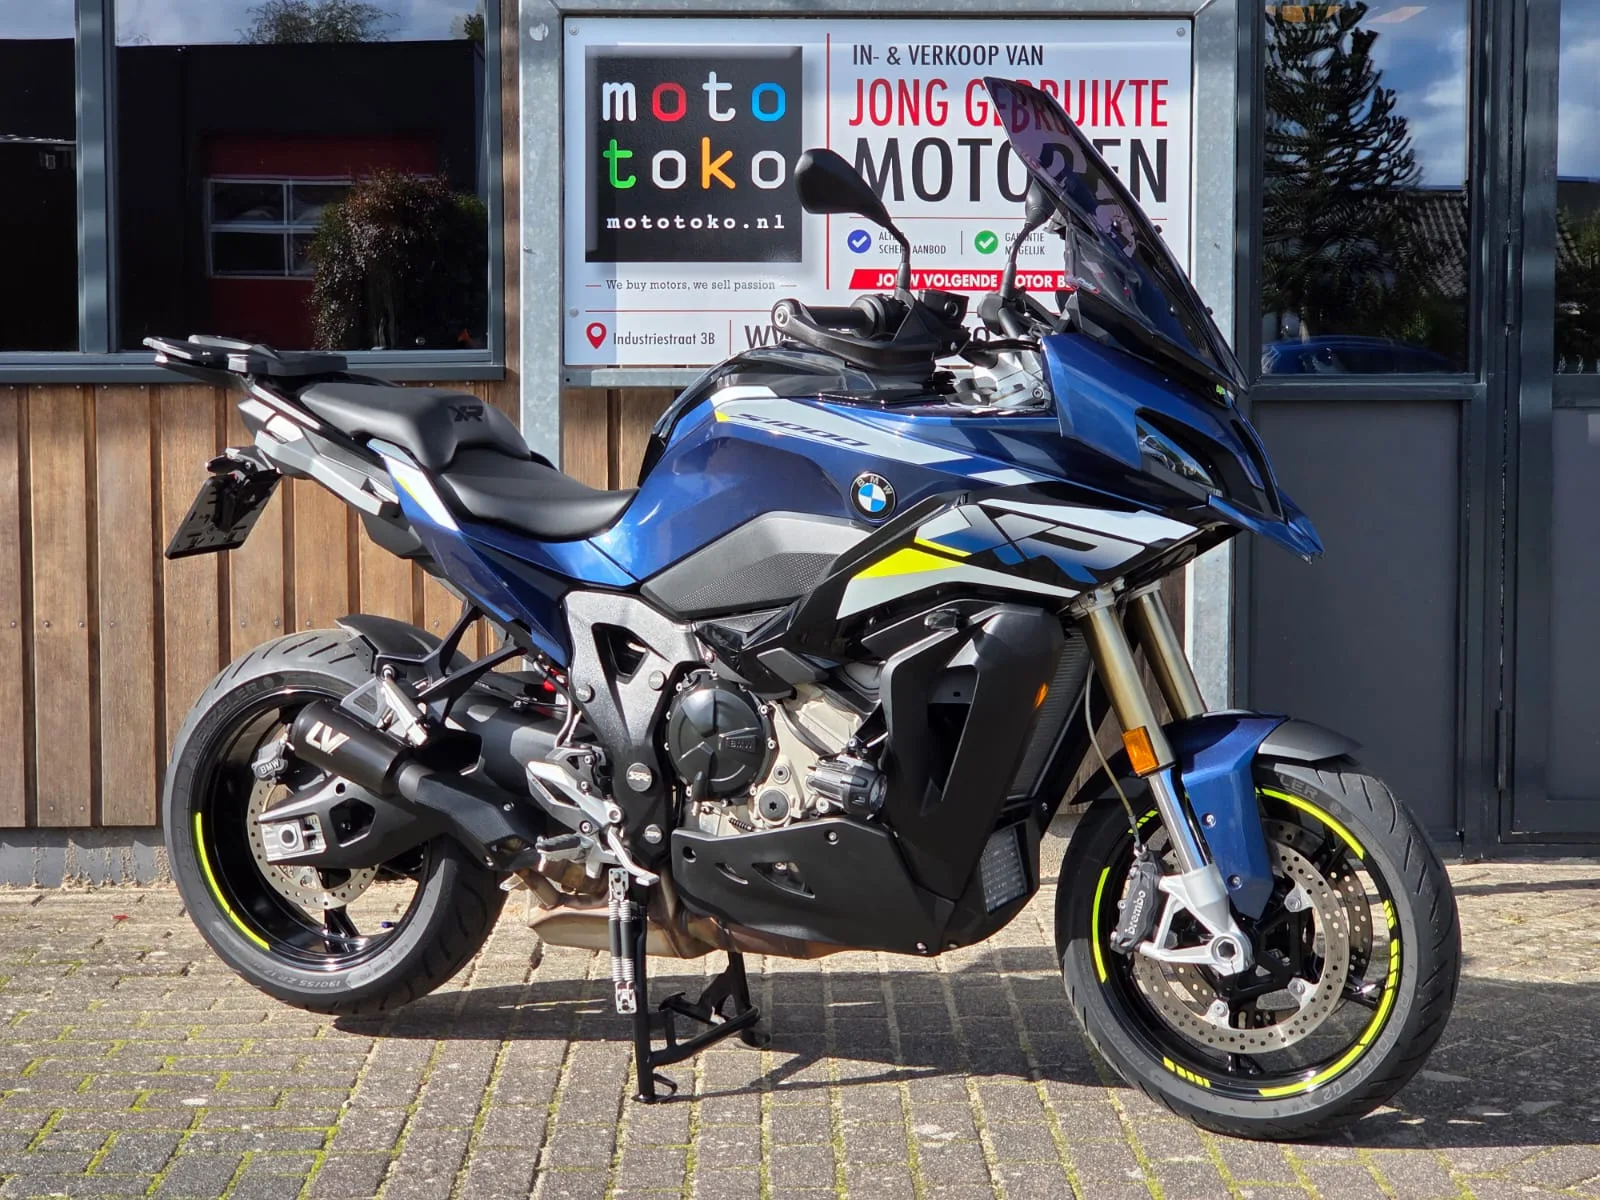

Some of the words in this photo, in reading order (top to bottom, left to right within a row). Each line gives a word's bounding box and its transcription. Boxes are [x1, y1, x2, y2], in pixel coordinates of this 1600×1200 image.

[852, 45, 880, 65] IN-
[886, 46, 901, 66] &
[908, 45, 999, 66] VERKOOP
[1007, 45, 1044, 66] VAN
[602, 71, 786, 122] moto
[849, 78, 949, 126] JONG
[602, 137, 786, 189] toko
[606, 214, 785, 230] mototoko.nl
[912, 244, 946, 254] AANBOD
[1005, 245, 1045, 256] MGELIJK
[606, 279, 623, 290] We
[626, 279, 647, 291] buy
[650, 279, 690, 291] motors,
[693, 281, 708, 290] we
[711, 279, 731, 290] sell
[734, 280, 776, 291] passion
[876, 273, 919, 287] JOW
[923, 273, 997, 288] VOLGENDE
[1002, 274, 1052, 288] OTOR
[613, 331, 697, 345] Industriestraat
[700, 332, 716, 345] 3B
[447, 405, 485, 421] XR
[856, 475, 893, 495] BMW
[259, 756, 282, 775] BMW
[1124, 889, 1147, 936] brembo
